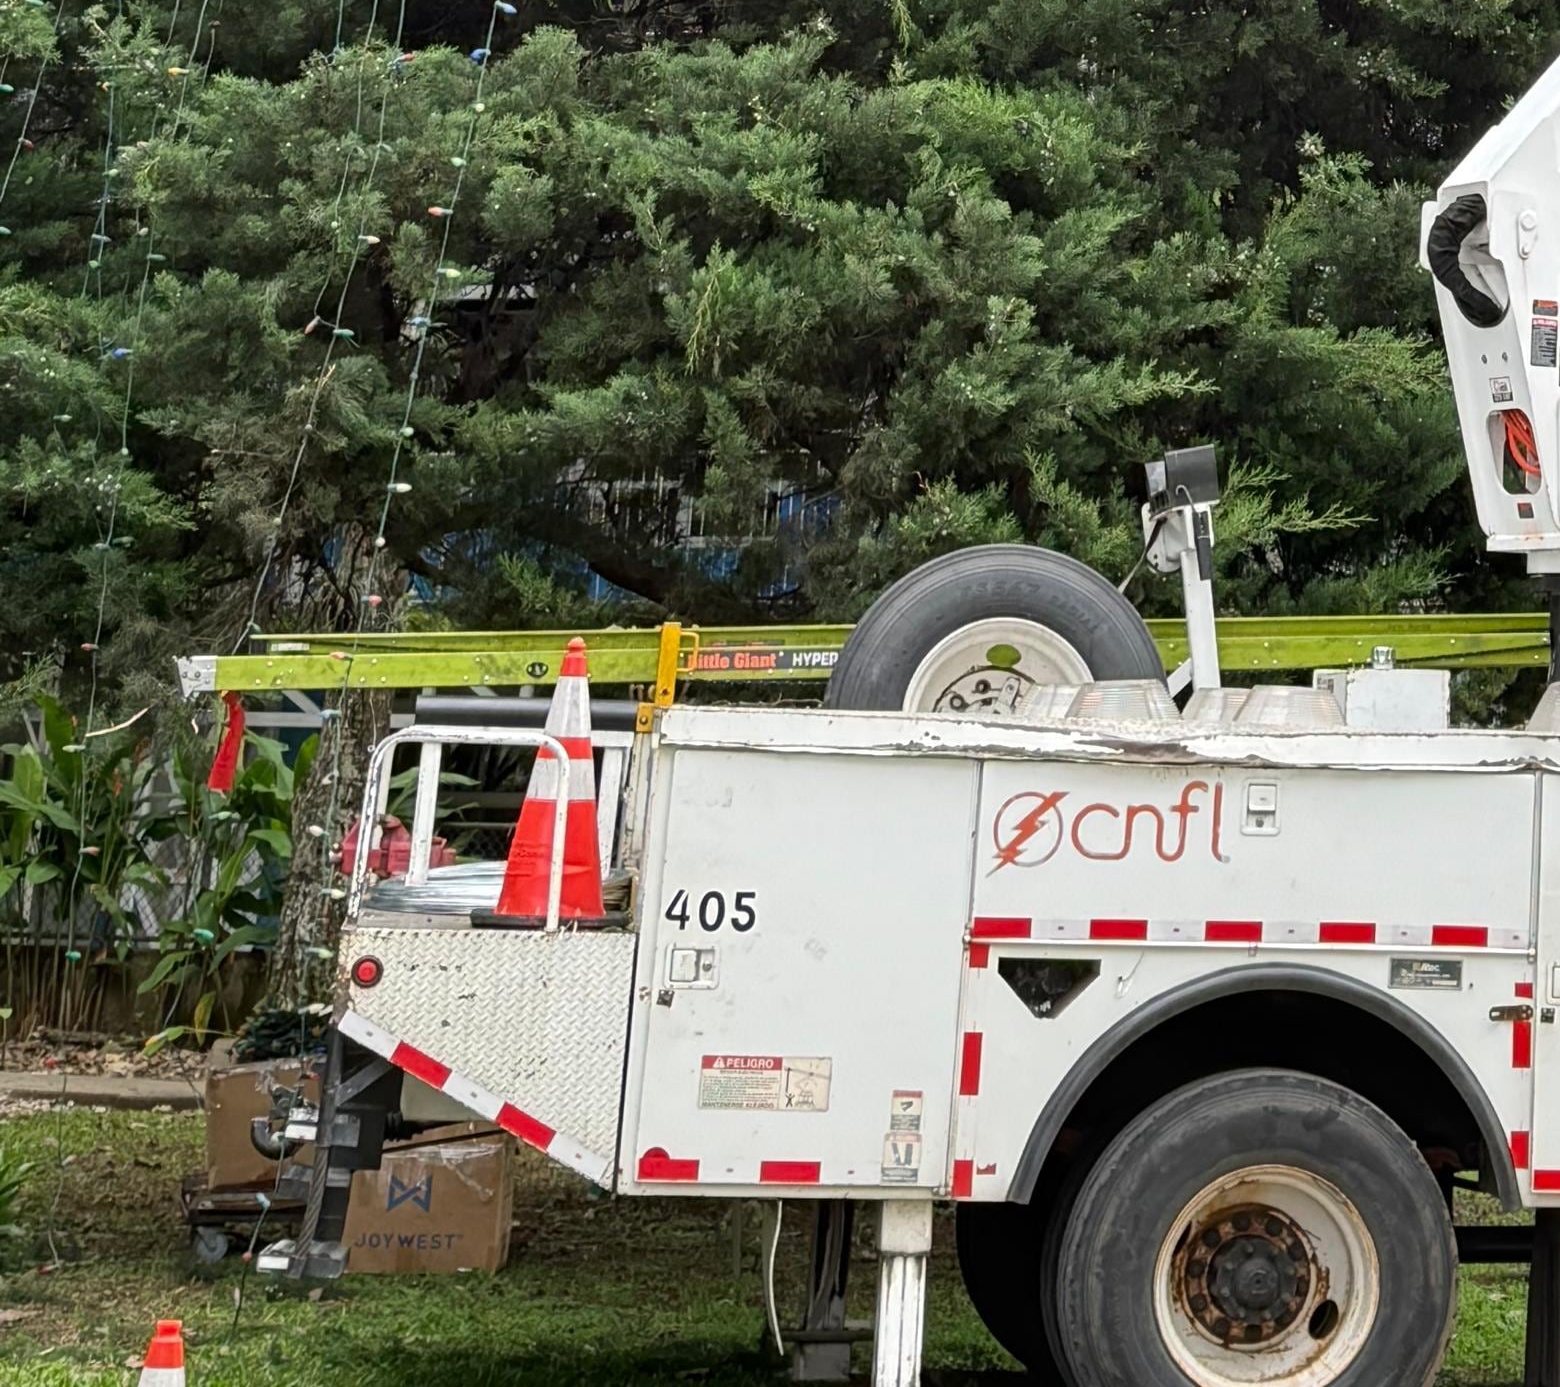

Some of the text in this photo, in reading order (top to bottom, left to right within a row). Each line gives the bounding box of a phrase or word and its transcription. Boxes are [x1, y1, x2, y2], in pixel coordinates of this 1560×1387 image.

[733, 652, 777, 669] Giant
[1071, 780, 1230, 863] cnfl
[665, 889, 756, 932] 405
[726, 1058, 774, 1069] PELIGRO
[354, 1232, 458, 1250] JOYWEST
